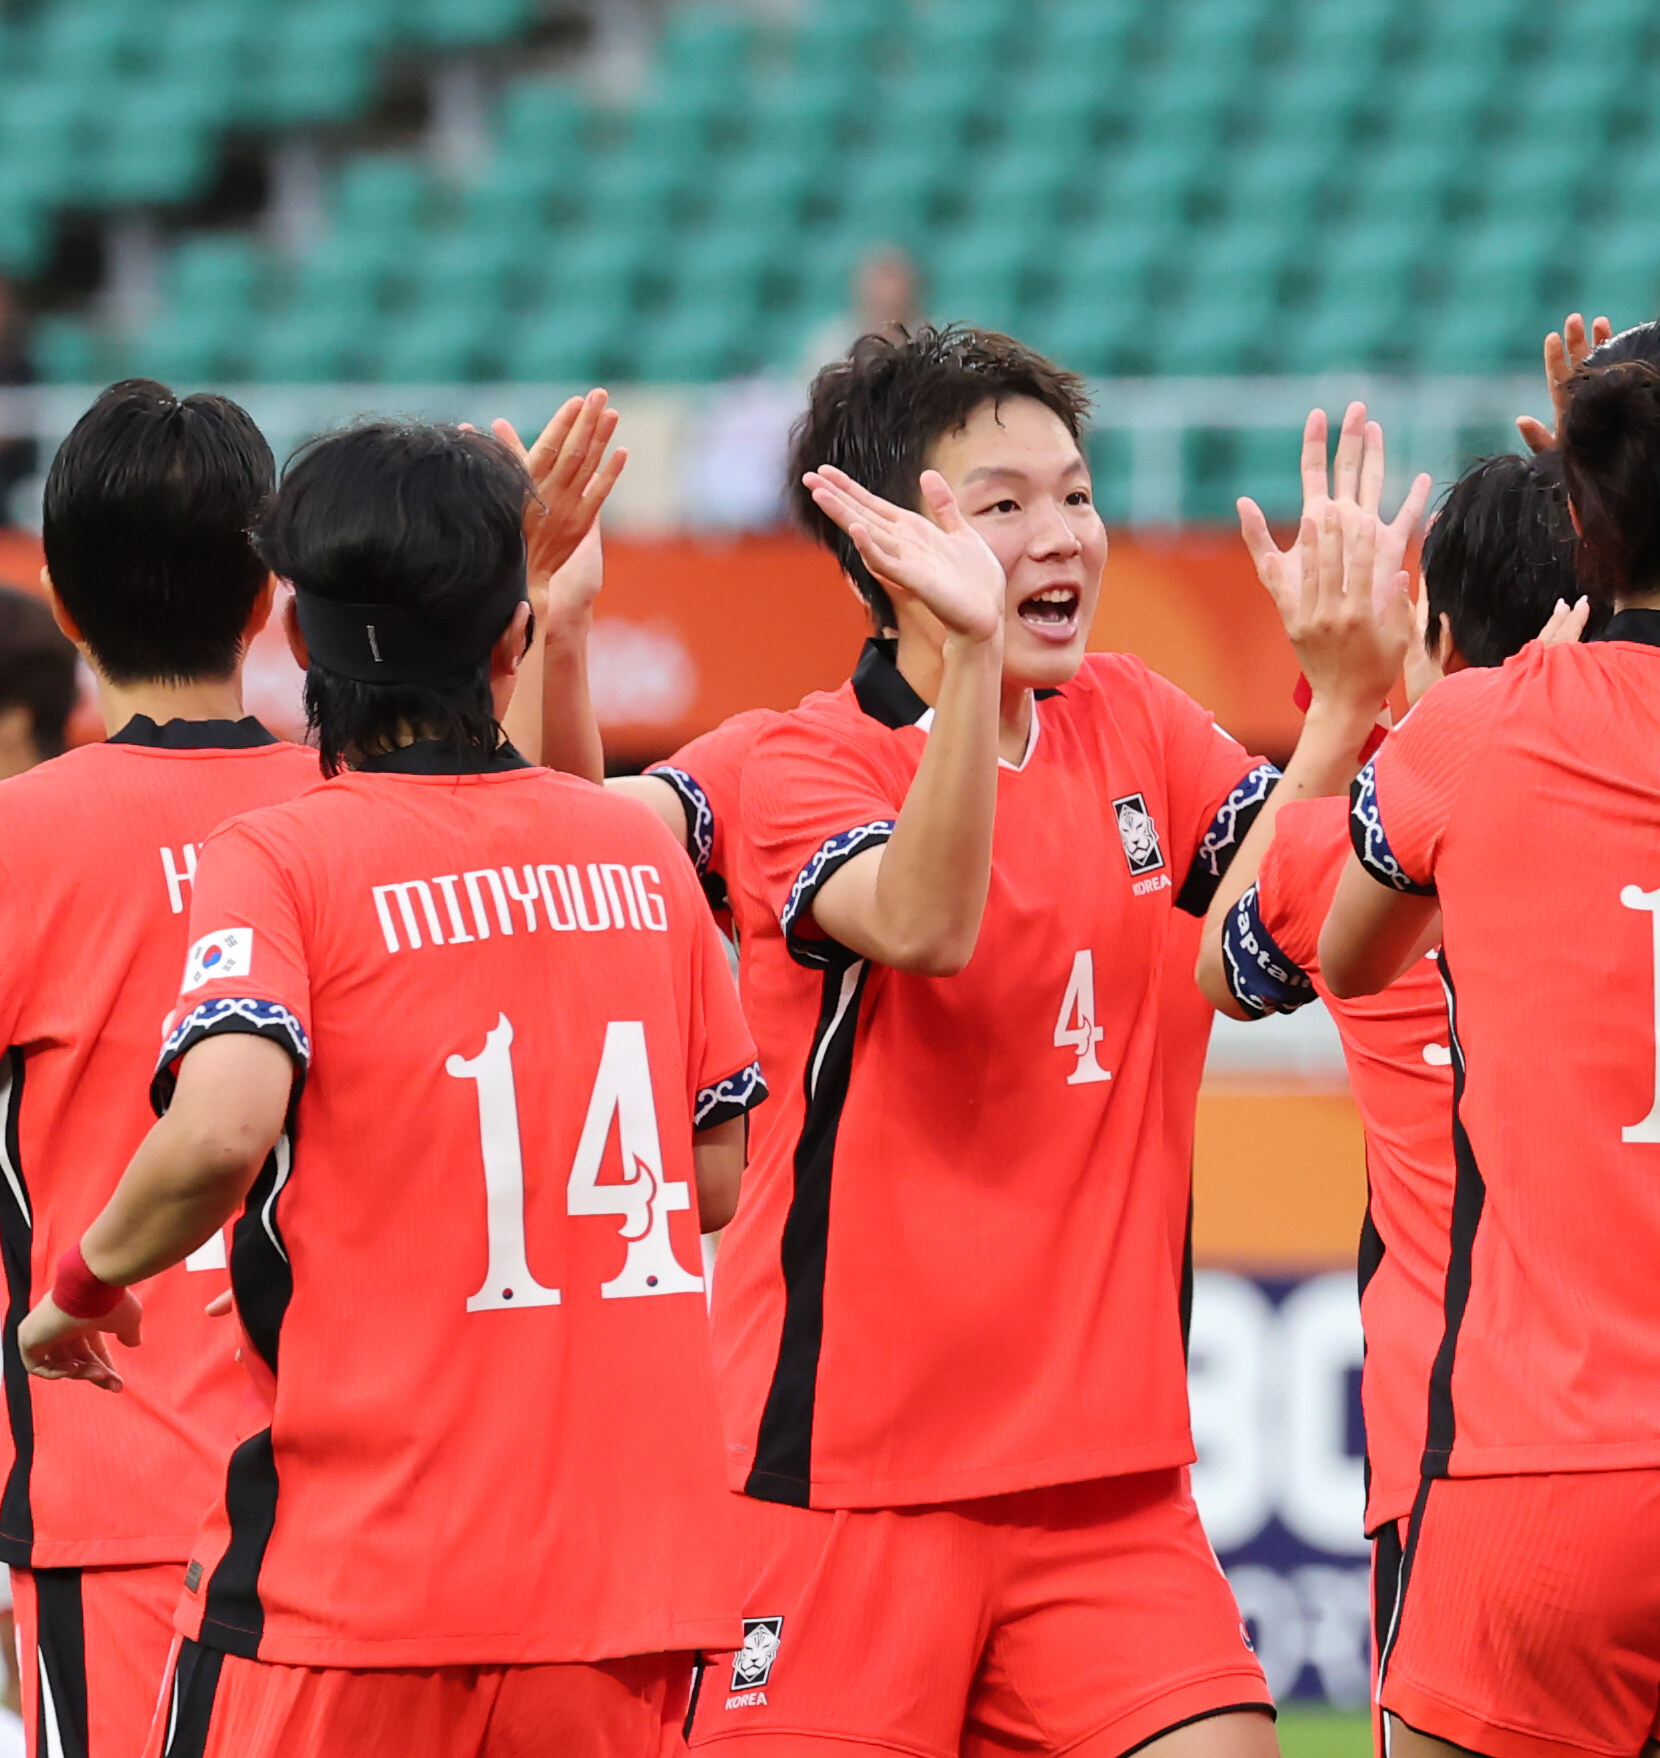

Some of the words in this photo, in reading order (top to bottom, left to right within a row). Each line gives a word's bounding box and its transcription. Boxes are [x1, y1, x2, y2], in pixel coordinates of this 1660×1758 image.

[160, 843, 204, 914] H
[372, 863, 668, 953] MINYOUNG
[1132, 874, 1172, 896] KOREA
[1054, 949, 1112, 1085] 4
[445, 1012, 704, 1312] 14
[725, 1692, 768, 1710] KOREA
